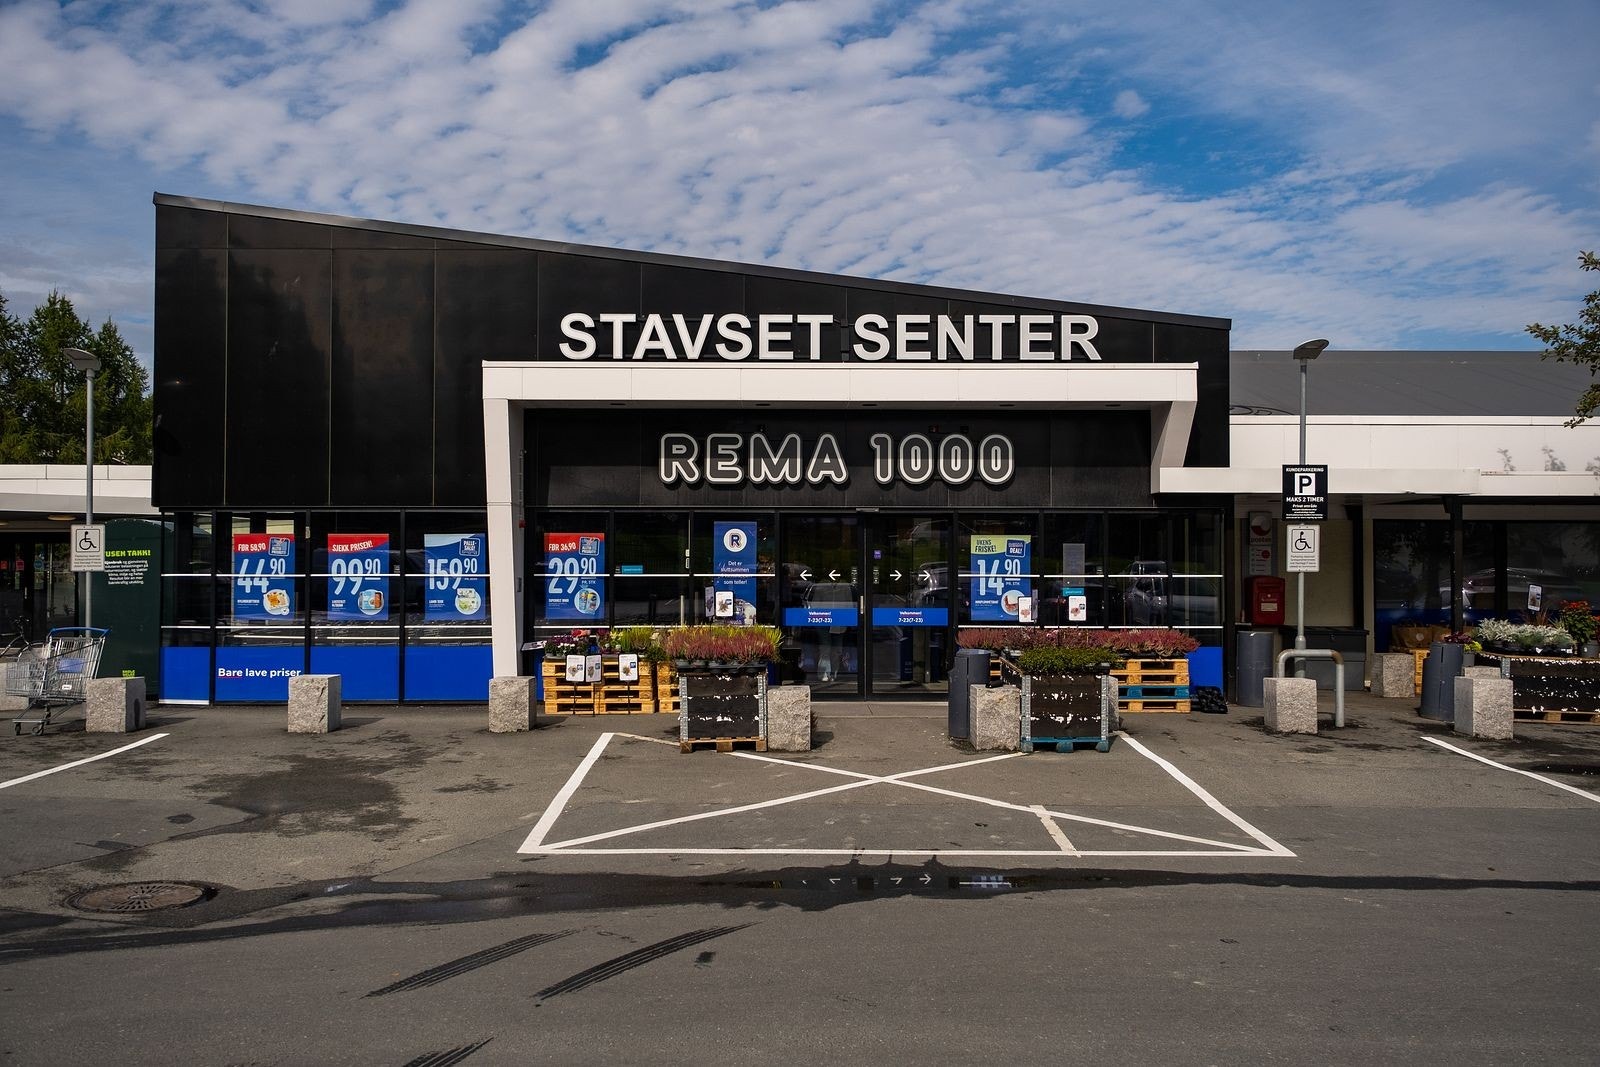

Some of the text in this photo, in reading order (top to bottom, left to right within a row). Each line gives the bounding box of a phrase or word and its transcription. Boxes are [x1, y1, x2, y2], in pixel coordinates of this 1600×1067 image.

[558, 312, 1102, 361] STAVSET SENTER
[660, 433, 1014, 484] REMA 1000
[1299, 475, 1312, 493] P
[127, 549, 151, 557] TAKK!
[250, 543, 266, 551] 58,90
[332, 540, 373, 552] SJEKK PRISEN!
[560, 542, 577, 551] 36,90
[237, 557, 286, 593] 44 90
[331, 558, 381, 595] 99 90
[427, 557, 478, 590] 159 90
[548, 557, 597, 594] 29 90
[977, 558, 1021, 596] 14 90
[218, 667, 301, 678] Bare lave priser
